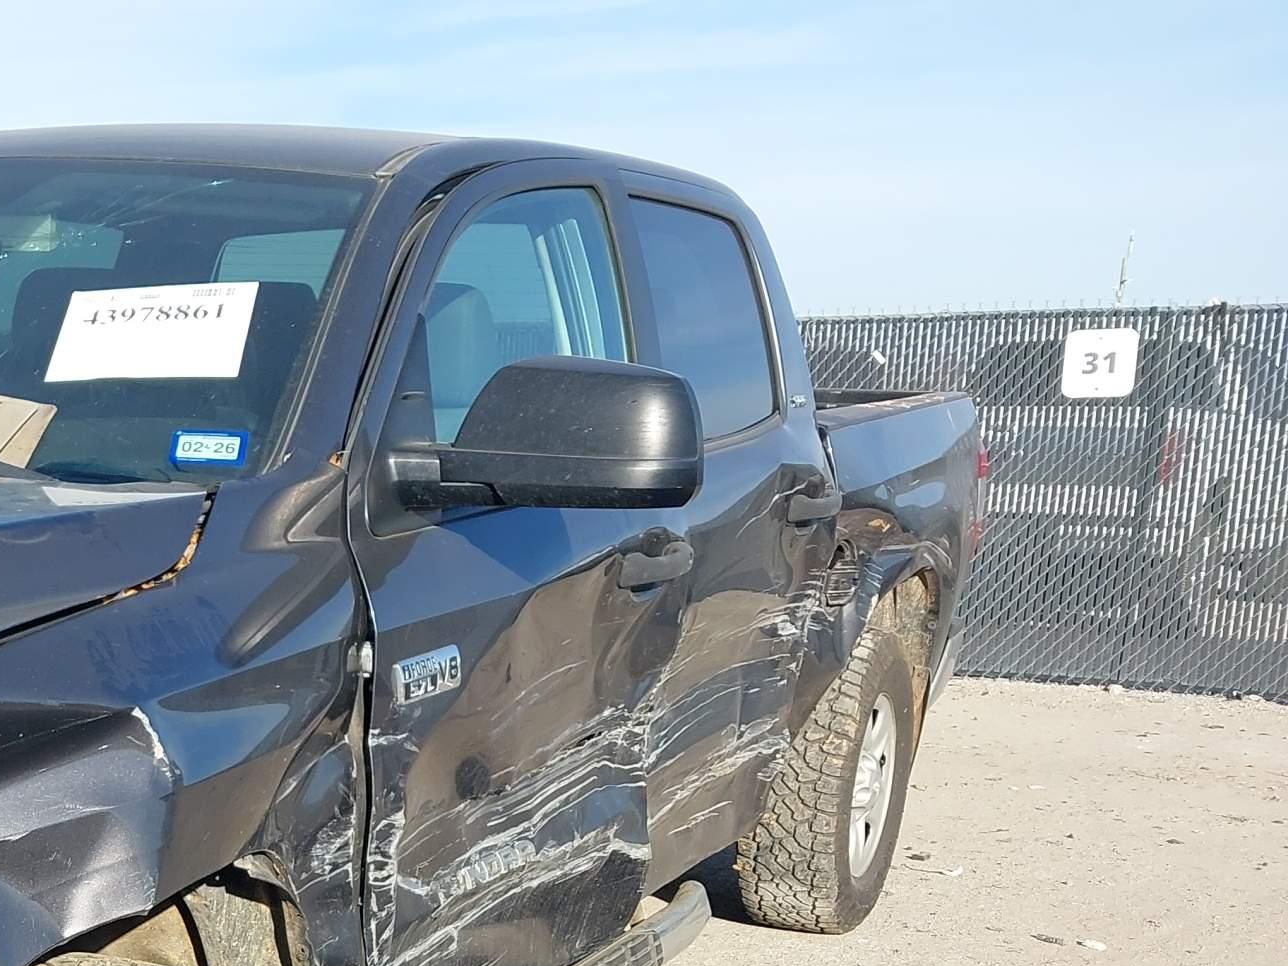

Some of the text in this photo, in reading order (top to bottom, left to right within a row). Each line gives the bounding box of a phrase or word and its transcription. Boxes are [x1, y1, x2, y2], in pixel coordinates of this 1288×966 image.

[83, 302, 226, 325] 43978861
[1081, 351, 1117, 375] 31
[438, 656, 459, 683] V8
